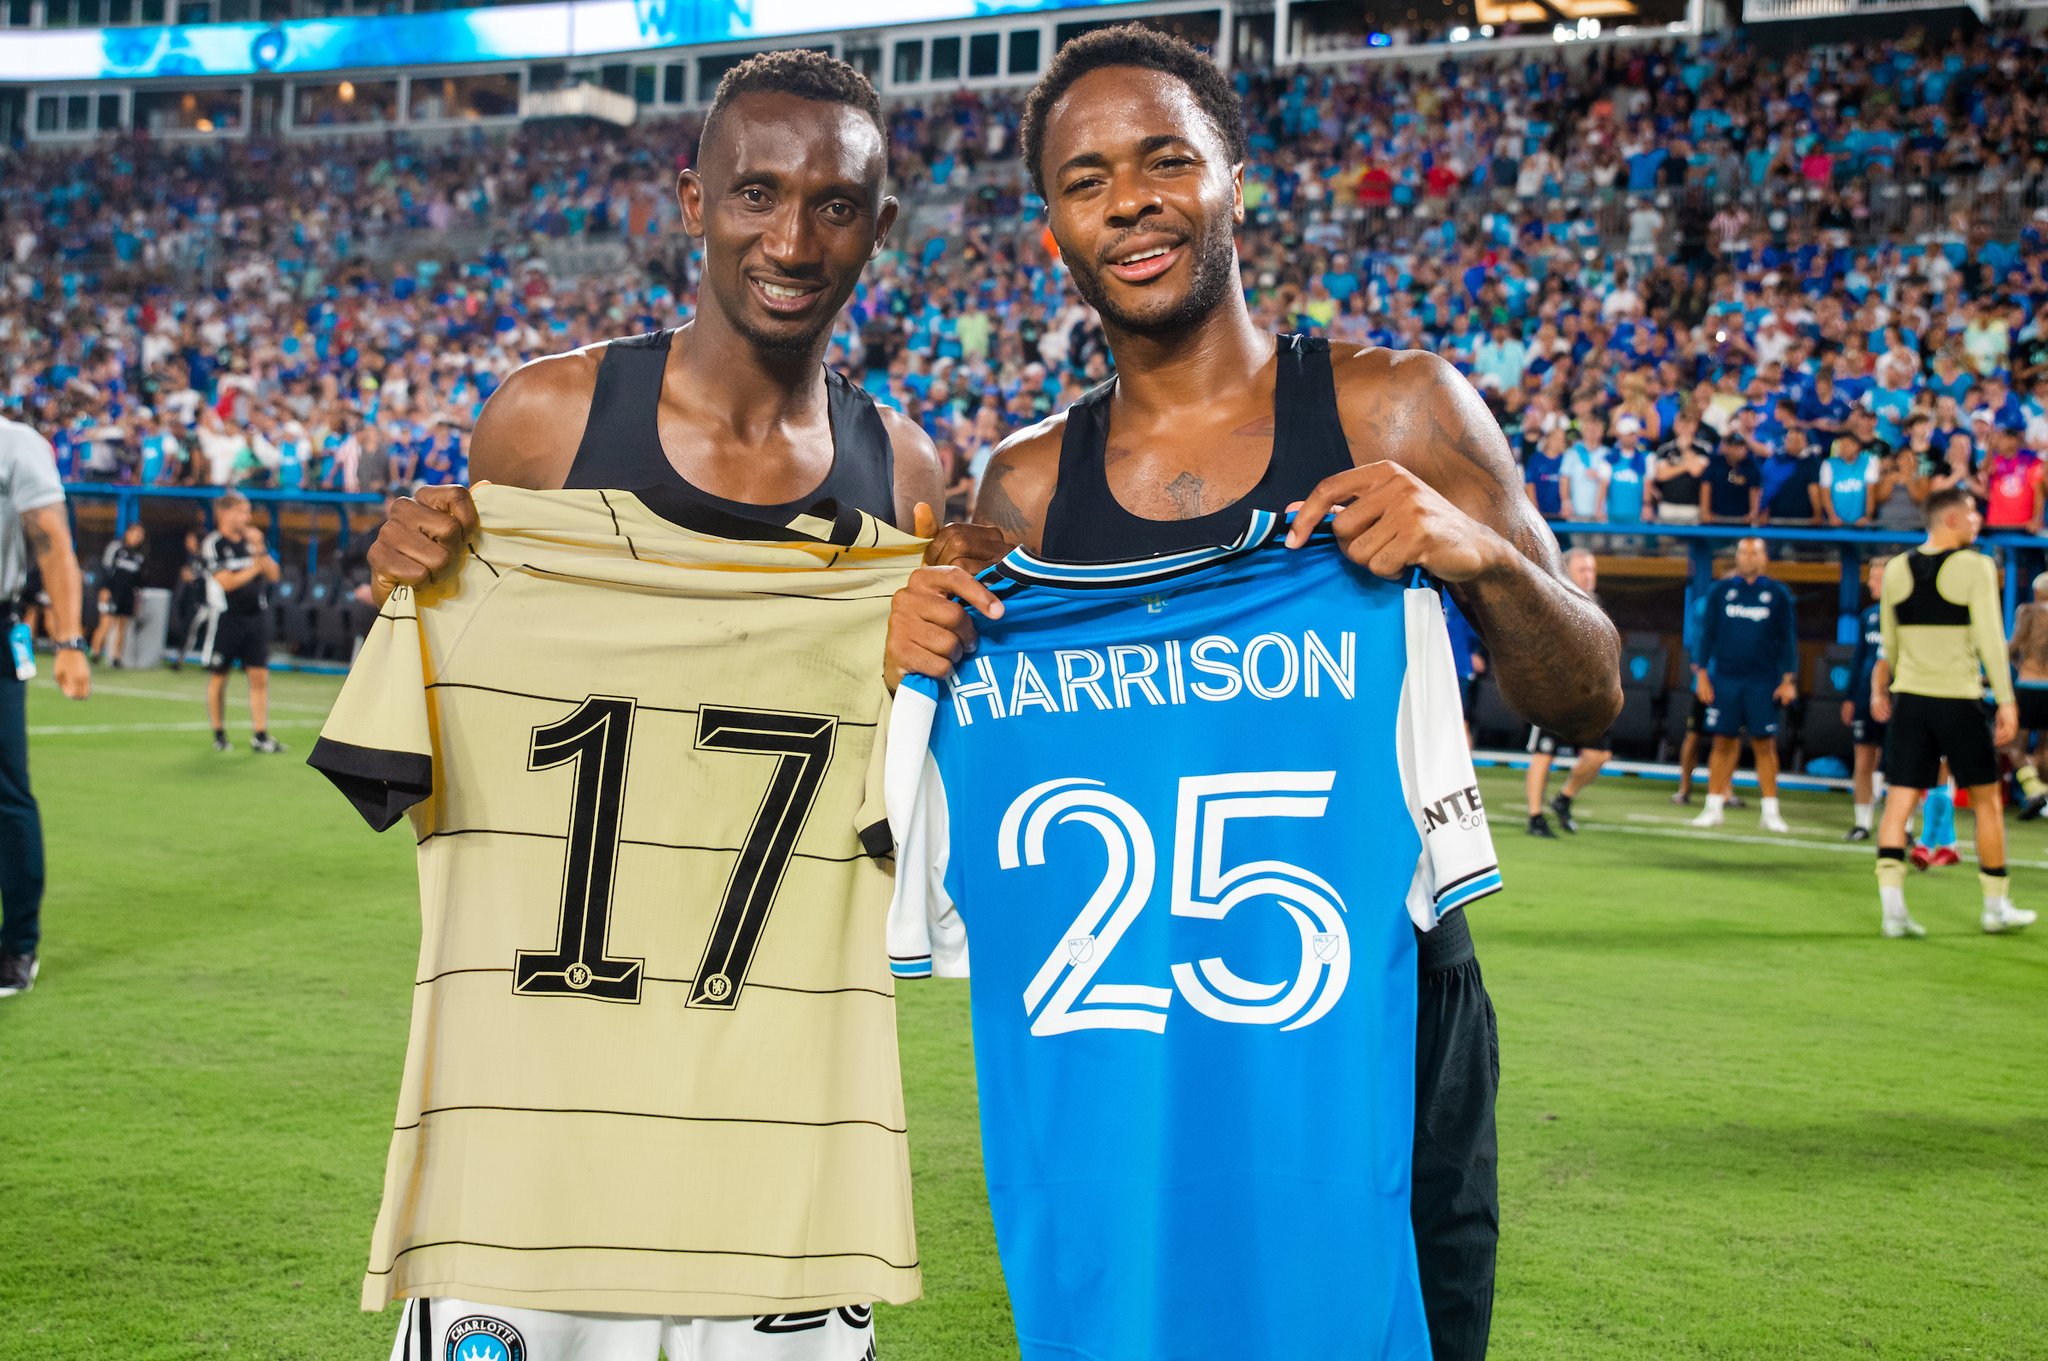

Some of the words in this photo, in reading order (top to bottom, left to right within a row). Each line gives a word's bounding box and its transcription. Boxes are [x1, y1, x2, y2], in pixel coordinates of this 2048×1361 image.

[946, 630, 1356, 727] HARRISON
[512, 694, 839, 1010] 17
[998, 771, 1350, 1036] 25
[451, 1320, 516, 1344] CHARLOTTE
